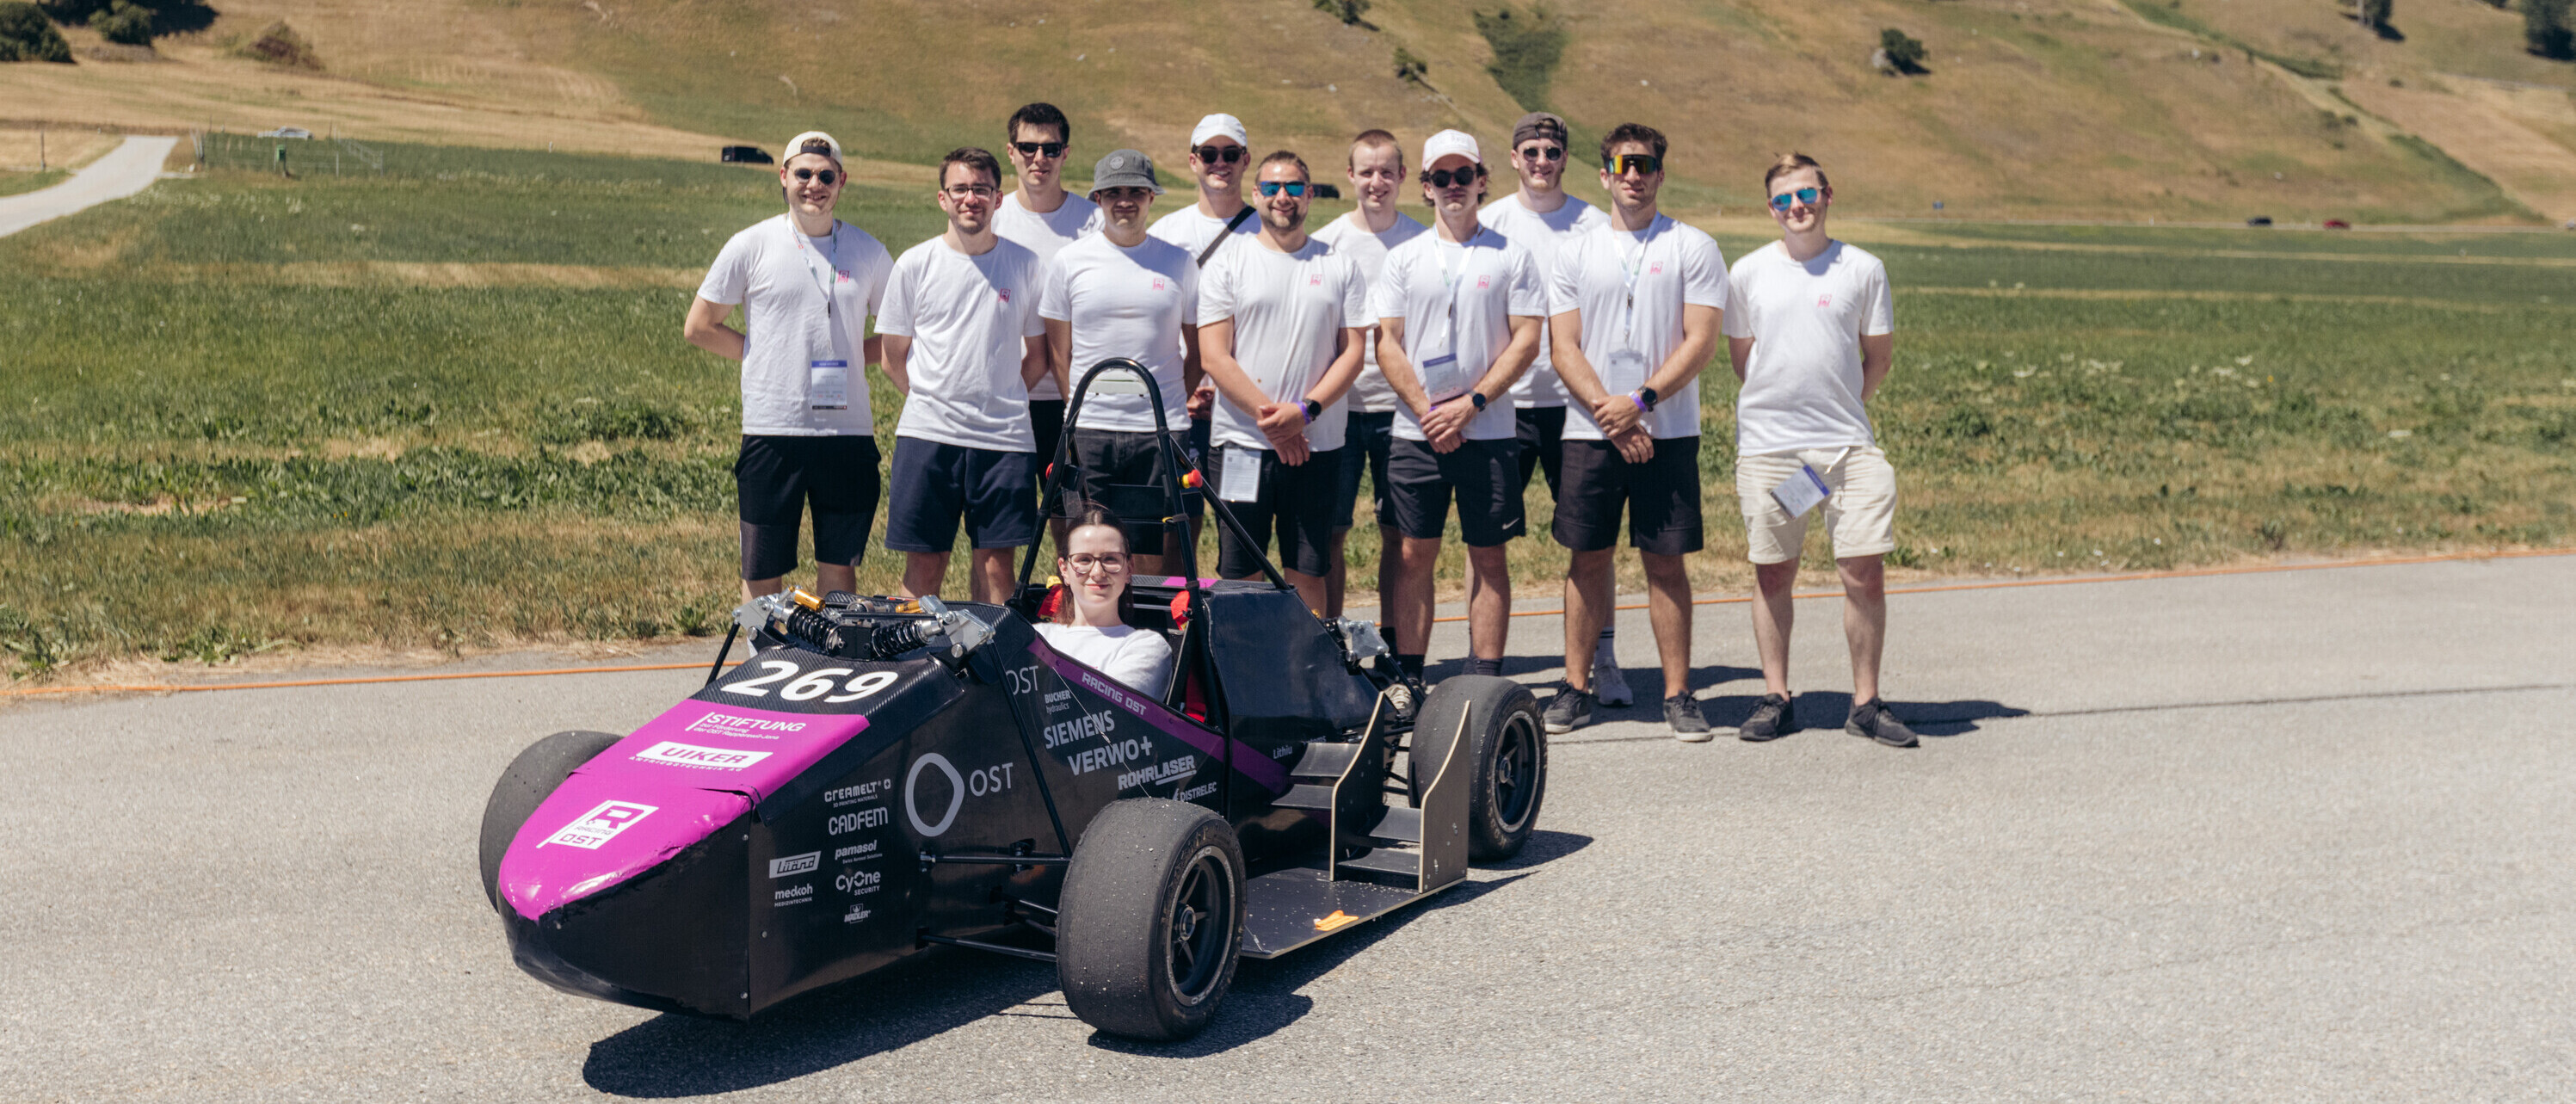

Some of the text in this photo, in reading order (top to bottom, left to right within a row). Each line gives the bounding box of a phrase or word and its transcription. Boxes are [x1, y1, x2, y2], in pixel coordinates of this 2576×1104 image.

[720, 660, 898, 703] 269
[1044, 689, 1071, 704] BUCHER
[1082, 672, 1147, 716] RACING OST
[1045, 702, 1069, 715] hydraulics
[706, 714, 806, 732] STIFTUNG
[1044, 710, 1115, 749] SIEMENS
[629, 756, 724, 771] ANTRIEBSTECHNIK
[661, 747, 749, 763] UIKER
[1067, 736, 1153, 776] VERWO+
[970, 762, 1014, 797] OST
[1118, 755, 1195, 791] ROHRLASER
[857, 793, 878, 803] MATERIALS
[1180, 781, 1217, 802] DISTRELEC
[829, 807, 888, 836] CADFEM
[559, 833, 603, 845] OST
[835, 839, 877, 860] pamasol
[835, 871, 881, 892] CyOne
[854, 885, 880, 896] SECURITY
[774, 883, 813, 900] medkoh
[774, 897, 813, 907] MEDIZINTECHNIK
